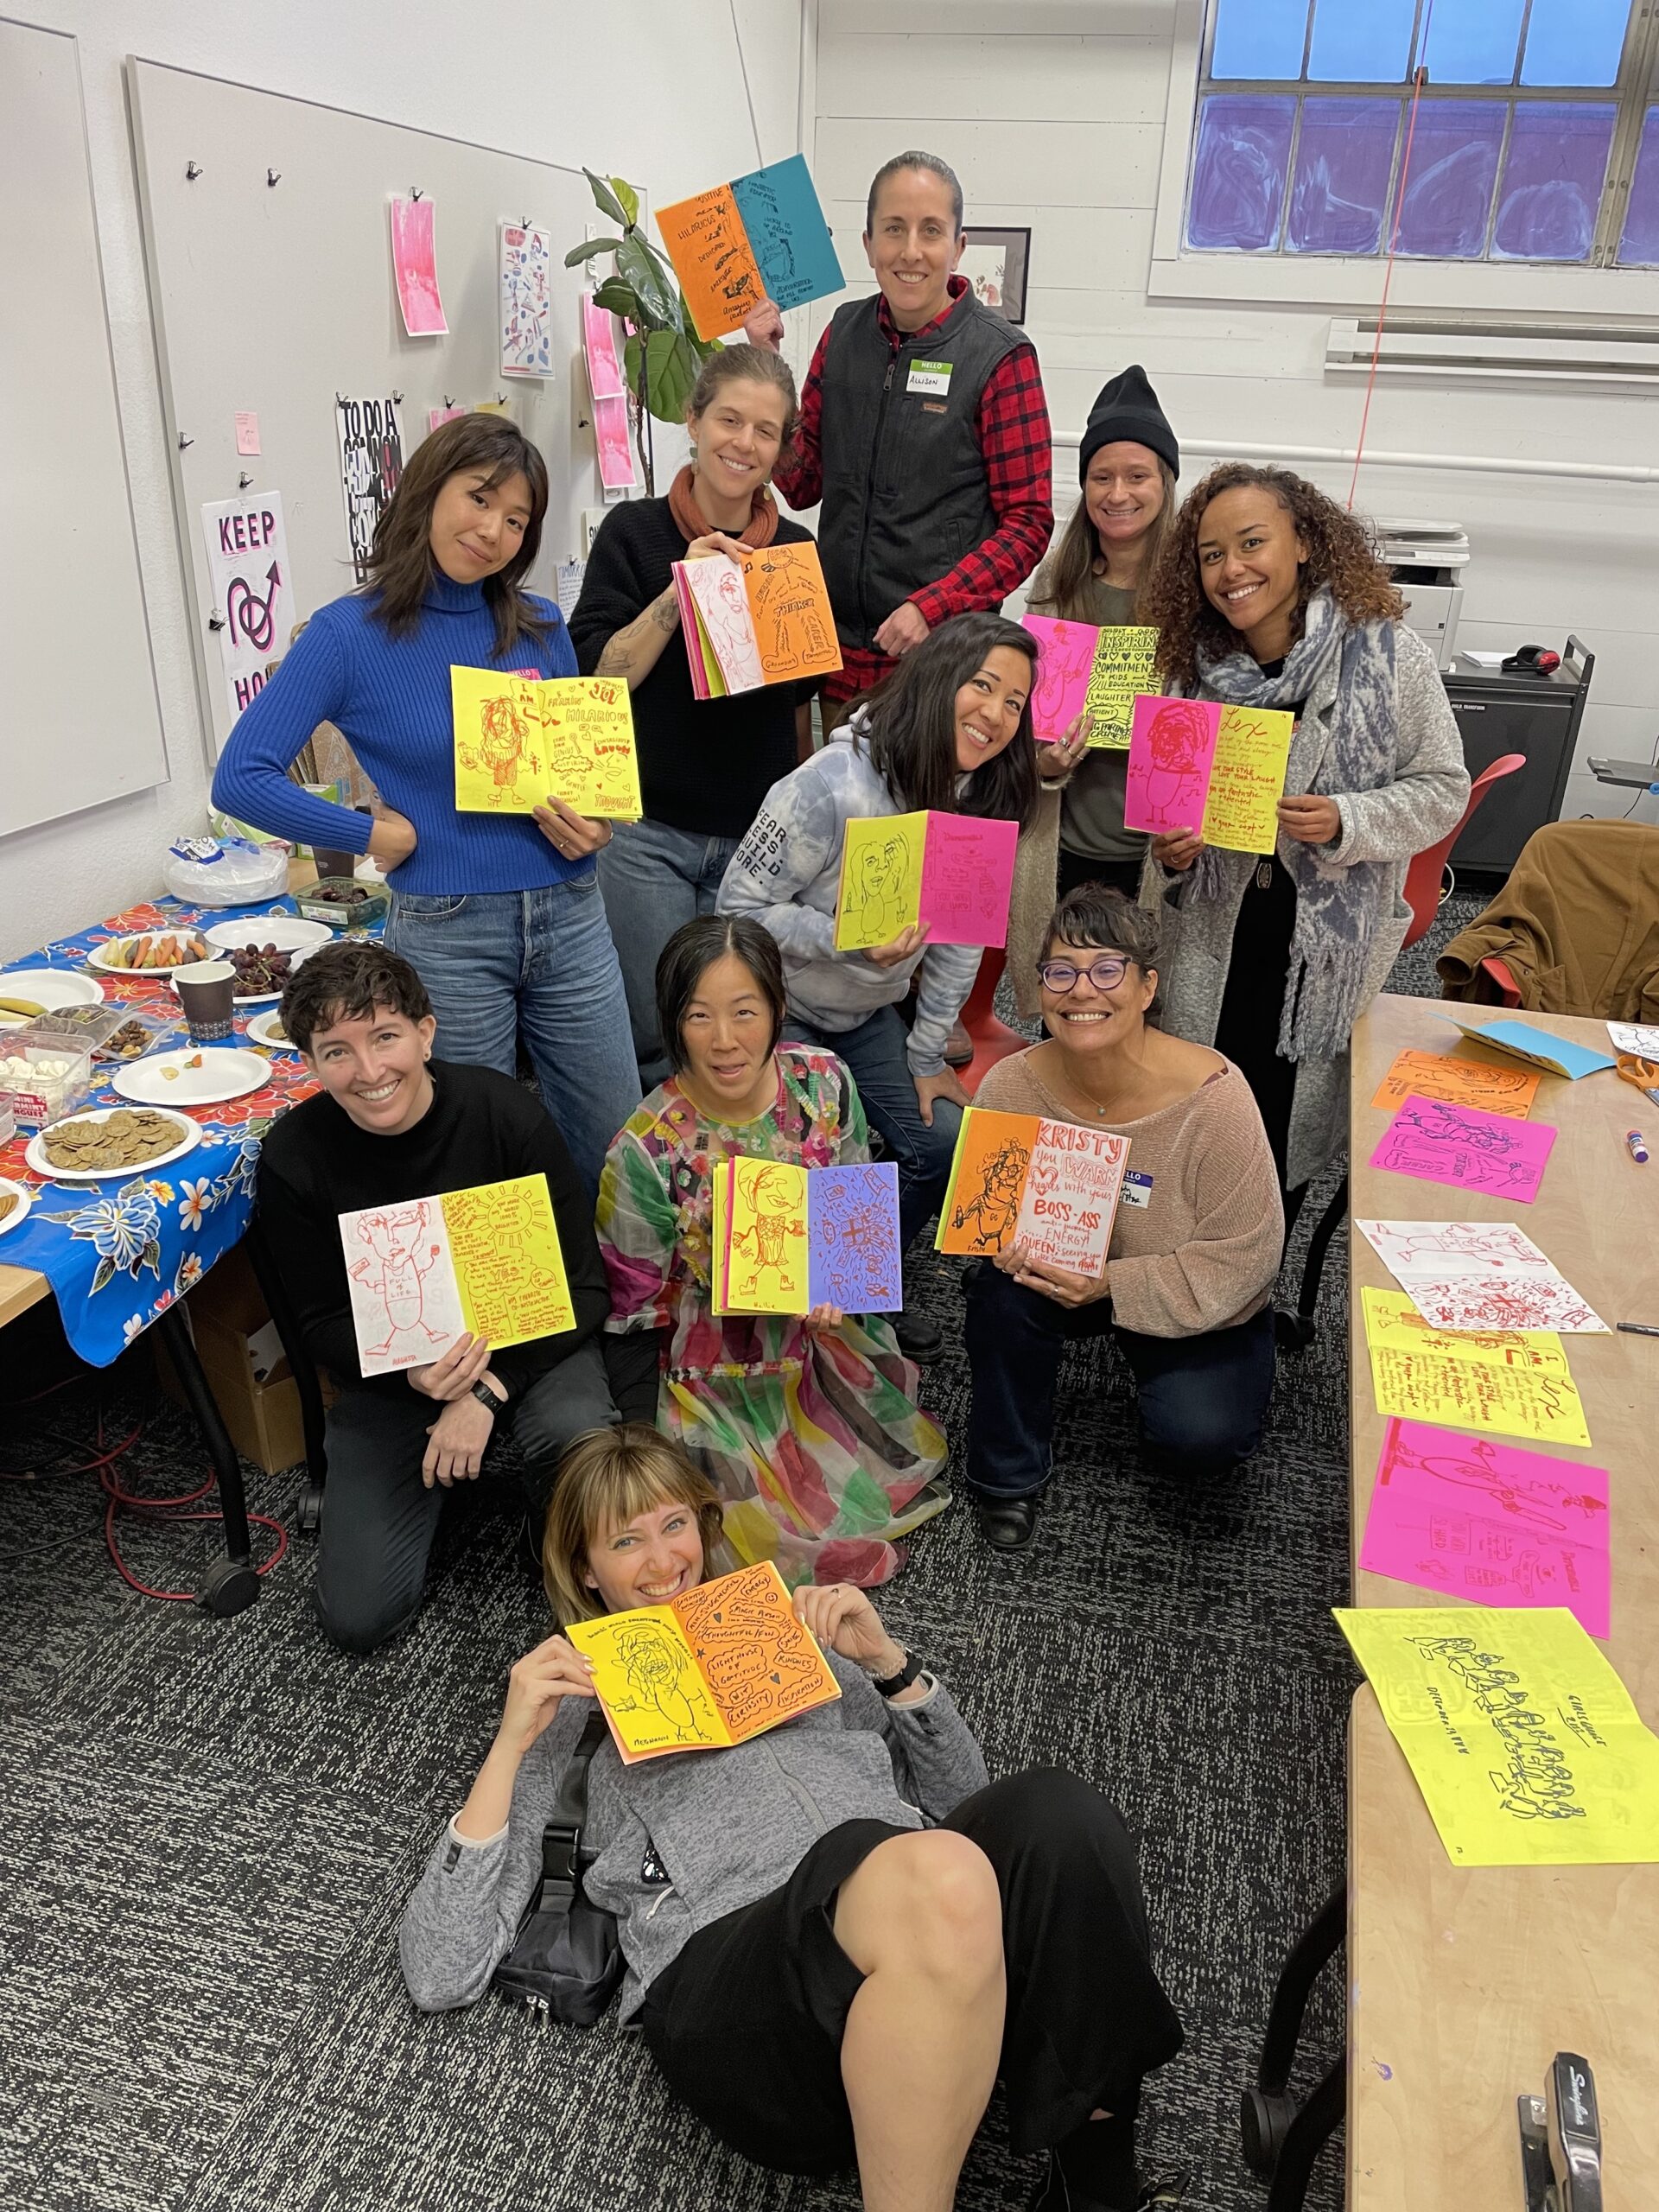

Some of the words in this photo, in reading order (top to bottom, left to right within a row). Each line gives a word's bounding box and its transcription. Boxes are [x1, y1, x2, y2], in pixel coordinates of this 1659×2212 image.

[921, 361, 942, 370] HELLO
[910, 375, 938, 385] ALLISON
[344, 401, 361, 439] TO
[363, 400, 382, 437] DO
[385, 400, 397, 435] A
[219, 510, 276, 555] KEEP
[589, 682, 624, 705] JOY
[1090, 692, 1131, 702] LAUGHTER
[565, 709, 628, 725] HILARIOUS
[1220, 708, 1268, 739] Lex
[1236, 767, 1255, 776] STYLE
[1228, 787, 1263, 798] fantastic
[748, 824, 784, 864] ESS.
[1035, 1120, 1122, 1165] KRISTY
[1037, 1150, 1057, 1166] you
[1028, 1179, 1060, 1192] hearts
[1065, 1181, 1087, 1194] with
[1090, 1190, 1113, 1205] your
[1033, 1198, 1072, 1222] BOSS
[1077, 1211, 1102, 1230] ASS
[1061, 1247, 1089, 1259] seeing
[1052, 1257, 1076, 1268] coming
[389, 1276, 413, 1285] FULL
[734, 1605, 754, 1615] MAGIC
[733, 1688, 750, 1700] WIT
